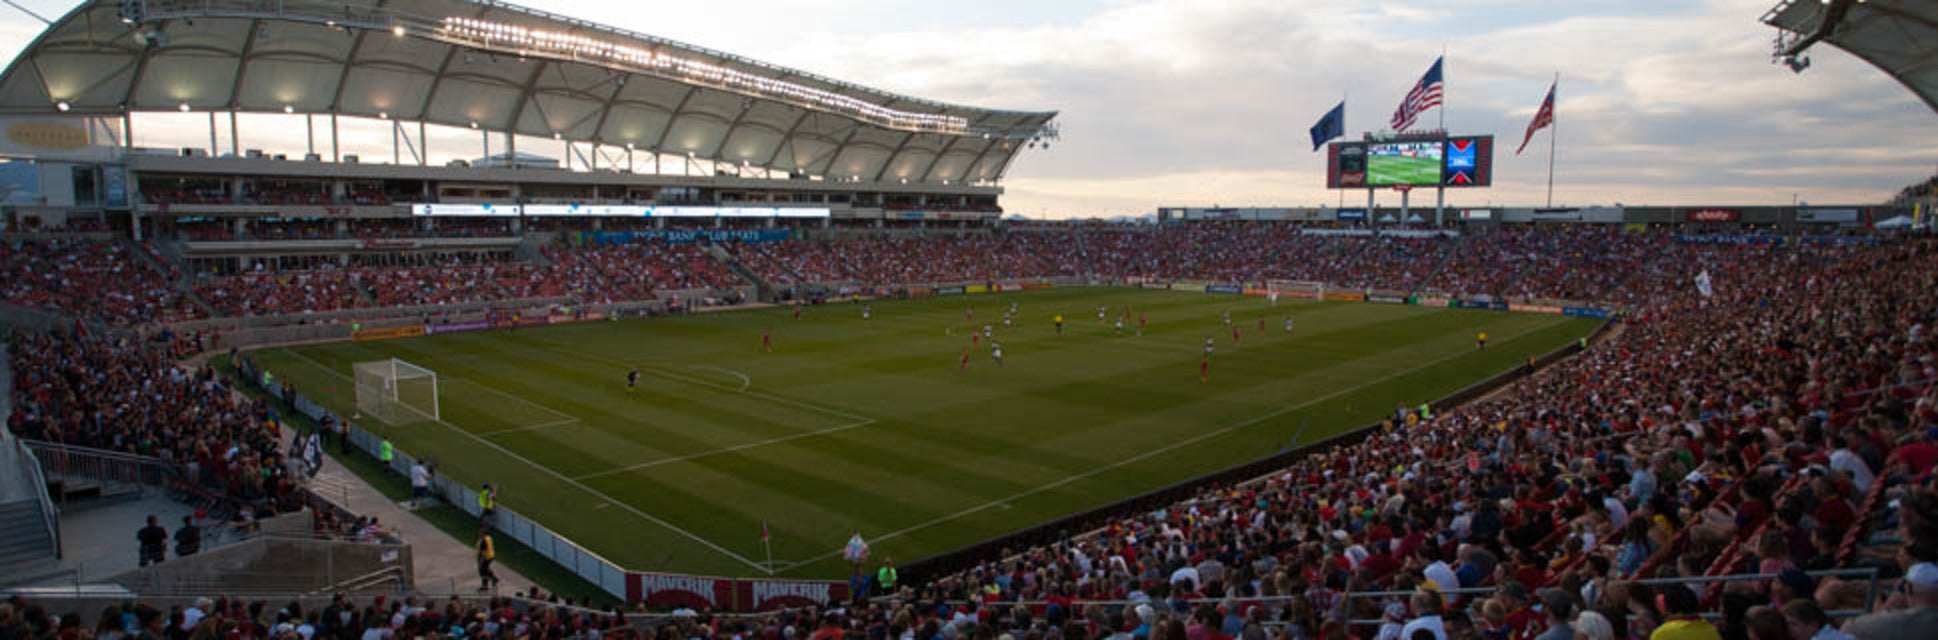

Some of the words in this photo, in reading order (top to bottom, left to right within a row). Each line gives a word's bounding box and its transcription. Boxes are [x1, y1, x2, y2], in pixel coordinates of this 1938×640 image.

[668, 231, 695, 241] BANK
[642, 575, 717, 606] MAVERIK
[752, 582, 831, 608] MAVERIK
